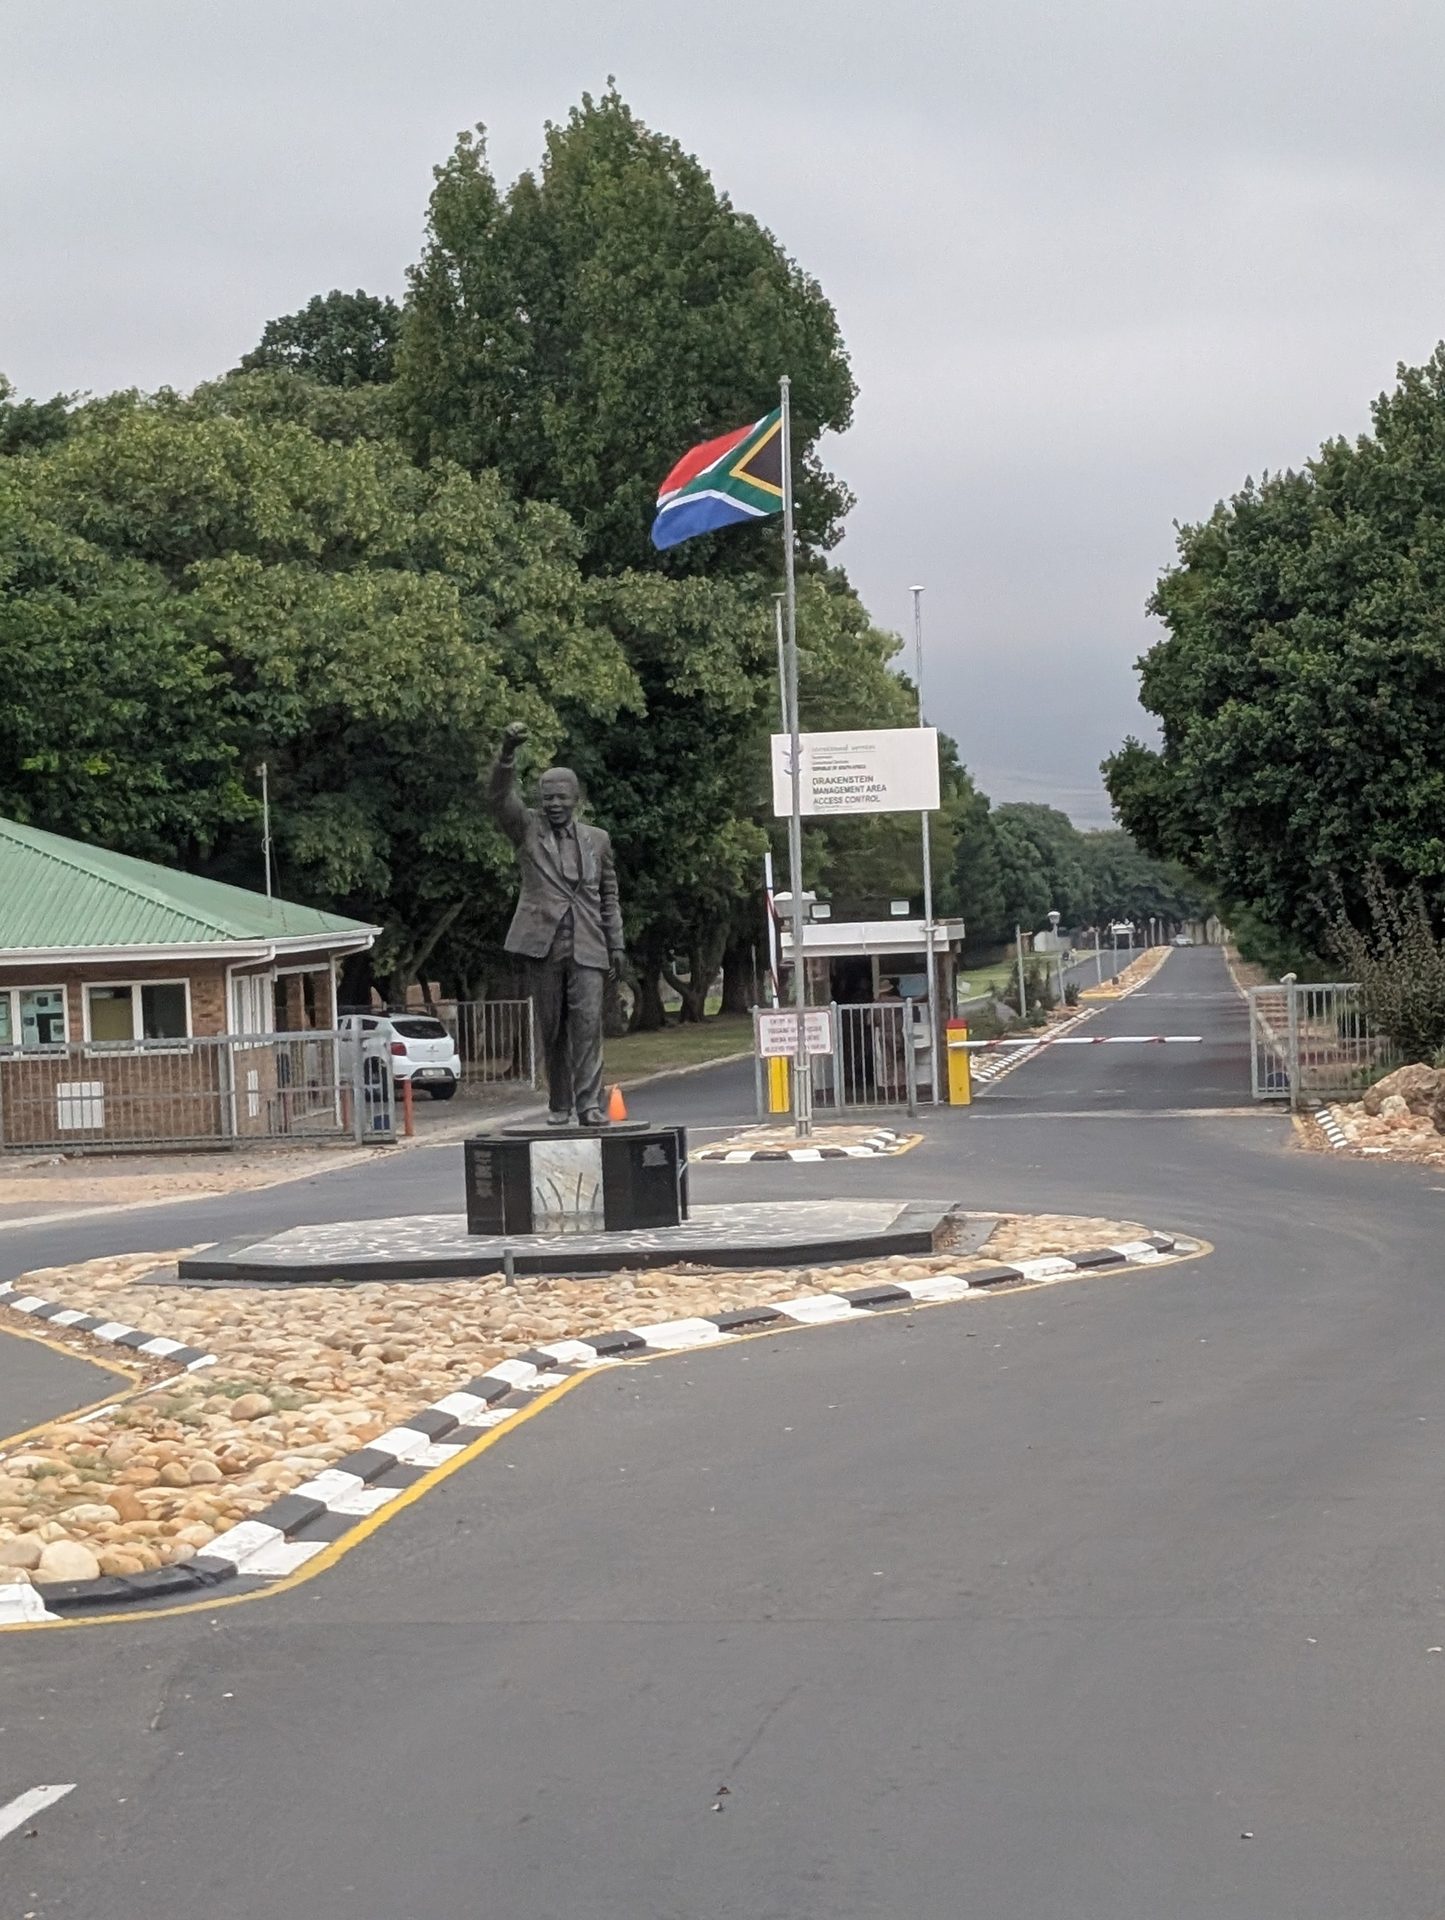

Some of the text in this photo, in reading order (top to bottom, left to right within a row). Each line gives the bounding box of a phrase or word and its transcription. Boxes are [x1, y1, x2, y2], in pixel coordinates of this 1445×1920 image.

[812, 784, 887, 795] MANAGEMENT AREA
[813, 794, 881, 805] ACCESS CONTROL
